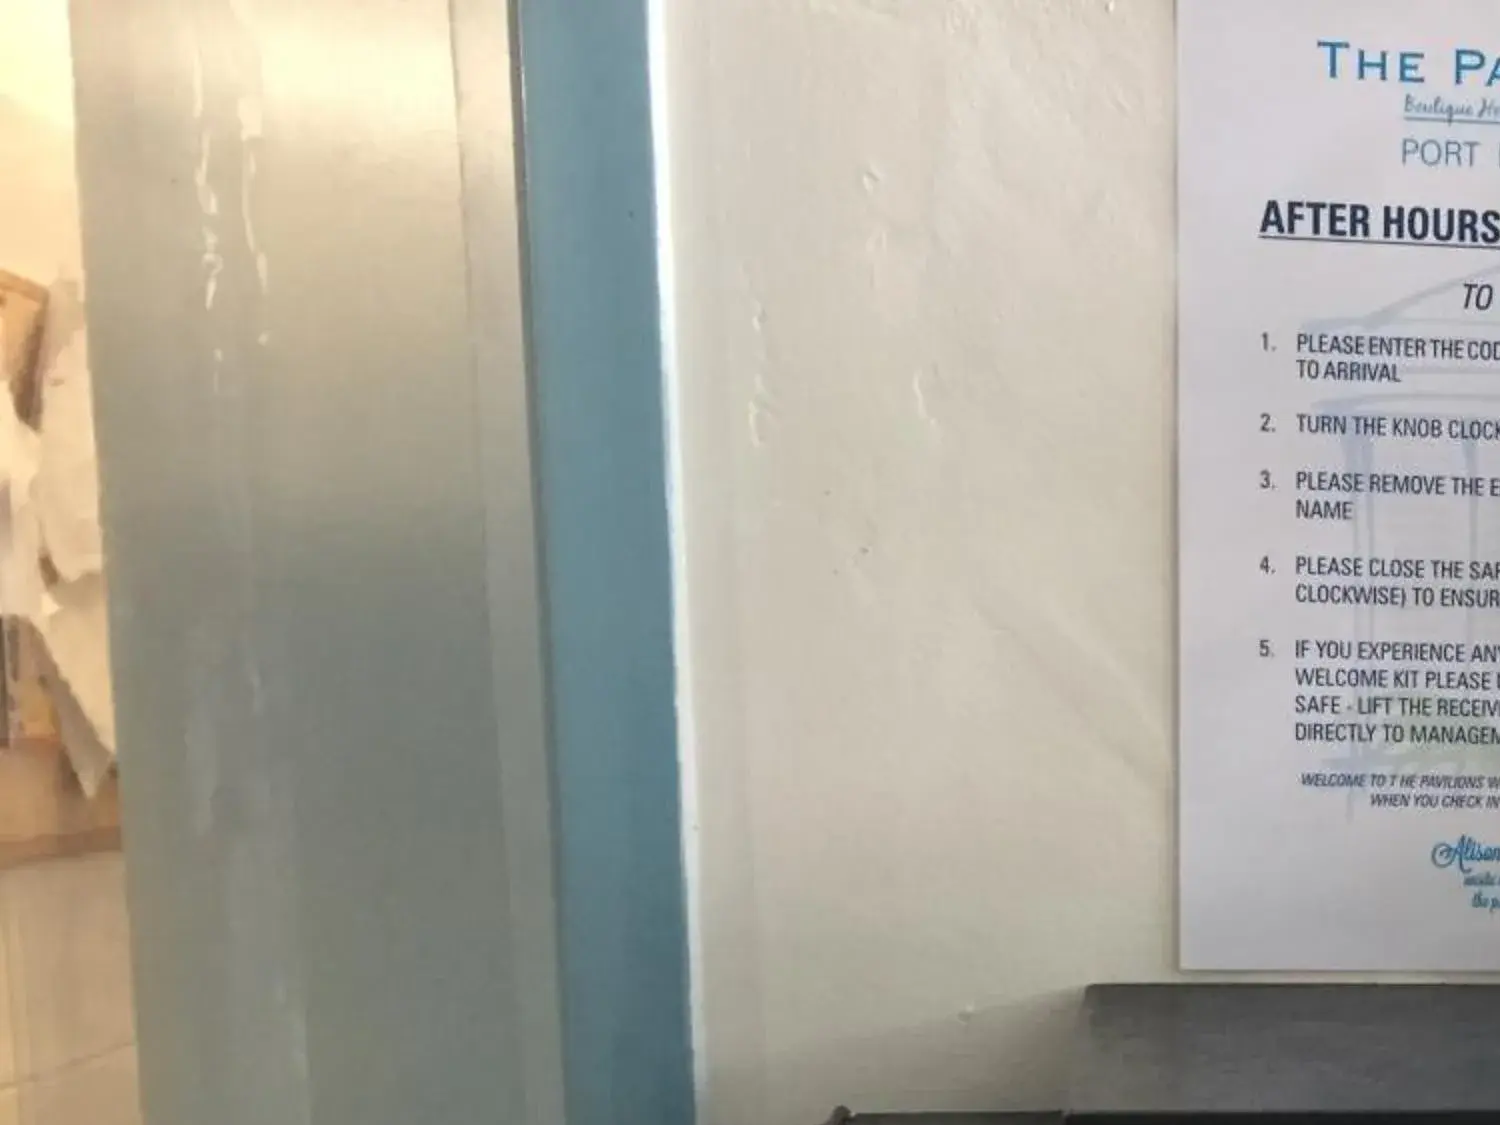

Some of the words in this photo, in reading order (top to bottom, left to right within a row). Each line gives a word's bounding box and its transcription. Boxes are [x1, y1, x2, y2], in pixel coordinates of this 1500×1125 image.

[1317, 40, 1425, 83] THE
[1403, 94, 1475, 125] Boutique
[1401, 139, 1481, 167] PORT
[1259, 199, 1370, 237] AFTER
[1463, 283, 1493, 310] TO
[1261, 332, 1277, 351] 1.
[1296, 333, 1364, 355] PLEASE
[1369, 336, 1426, 357] ENTER
[1430, 338, 1463, 359] THE
[1296, 359, 1319, 379] TO
[1323, 361, 1401, 382] ARRIVAL
[1260, 413, 1276, 433] 2.
[1296, 414, 1346, 435] TURN
[1352, 416, 1388, 436] THE
[1392, 417, 1443, 437] KNOB
[1259, 469, 1277, 490] 3.
[1296, 471, 1363, 492] PLEASE
[1369, 474, 1445, 495] REMOVE
[1452, 477, 1485, 496] THE
[1296, 499, 1353, 520] NAME
[1259, 556, 1276, 574] 4.
[1296, 556, 1363, 577] PLEASE
[1369, 558, 1424, 578] CLOSE
[1430, 560, 1463, 579] THE
[1296, 584, 1406, 608] CLOCKWISE)
[1412, 587, 1433, 606] TO
[1295, 640, 1310, 658] IF
[1316, 641, 1351, 659] YOU
[1358, 641, 1465, 662] EXPERIENCE
[1295, 668, 1388, 688] WELCOME
[1393, 670, 1420, 689] KIT
[1425, 671, 1491, 690] PLEASE
[1295, 696, 1340, 714] SAFE
[1357, 697, 1393, 715] LIFT
[1399, 697, 1432, 716] THE
[1295, 723, 1376, 742] DIRECTLY
[1383, 725, 1404, 743] TO
[1300, 773, 1366, 788] WELCOME
[1370, 774, 1386, 788] TO
[1420, 775, 1485, 790] PAVILIONS
[1371, 794, 1409, 808] WHEN
[1414, 795, 1439, 809] YOU
[1441, 795, 1482, 809] CHECK
[1486, 796, 1499, 809] IN
